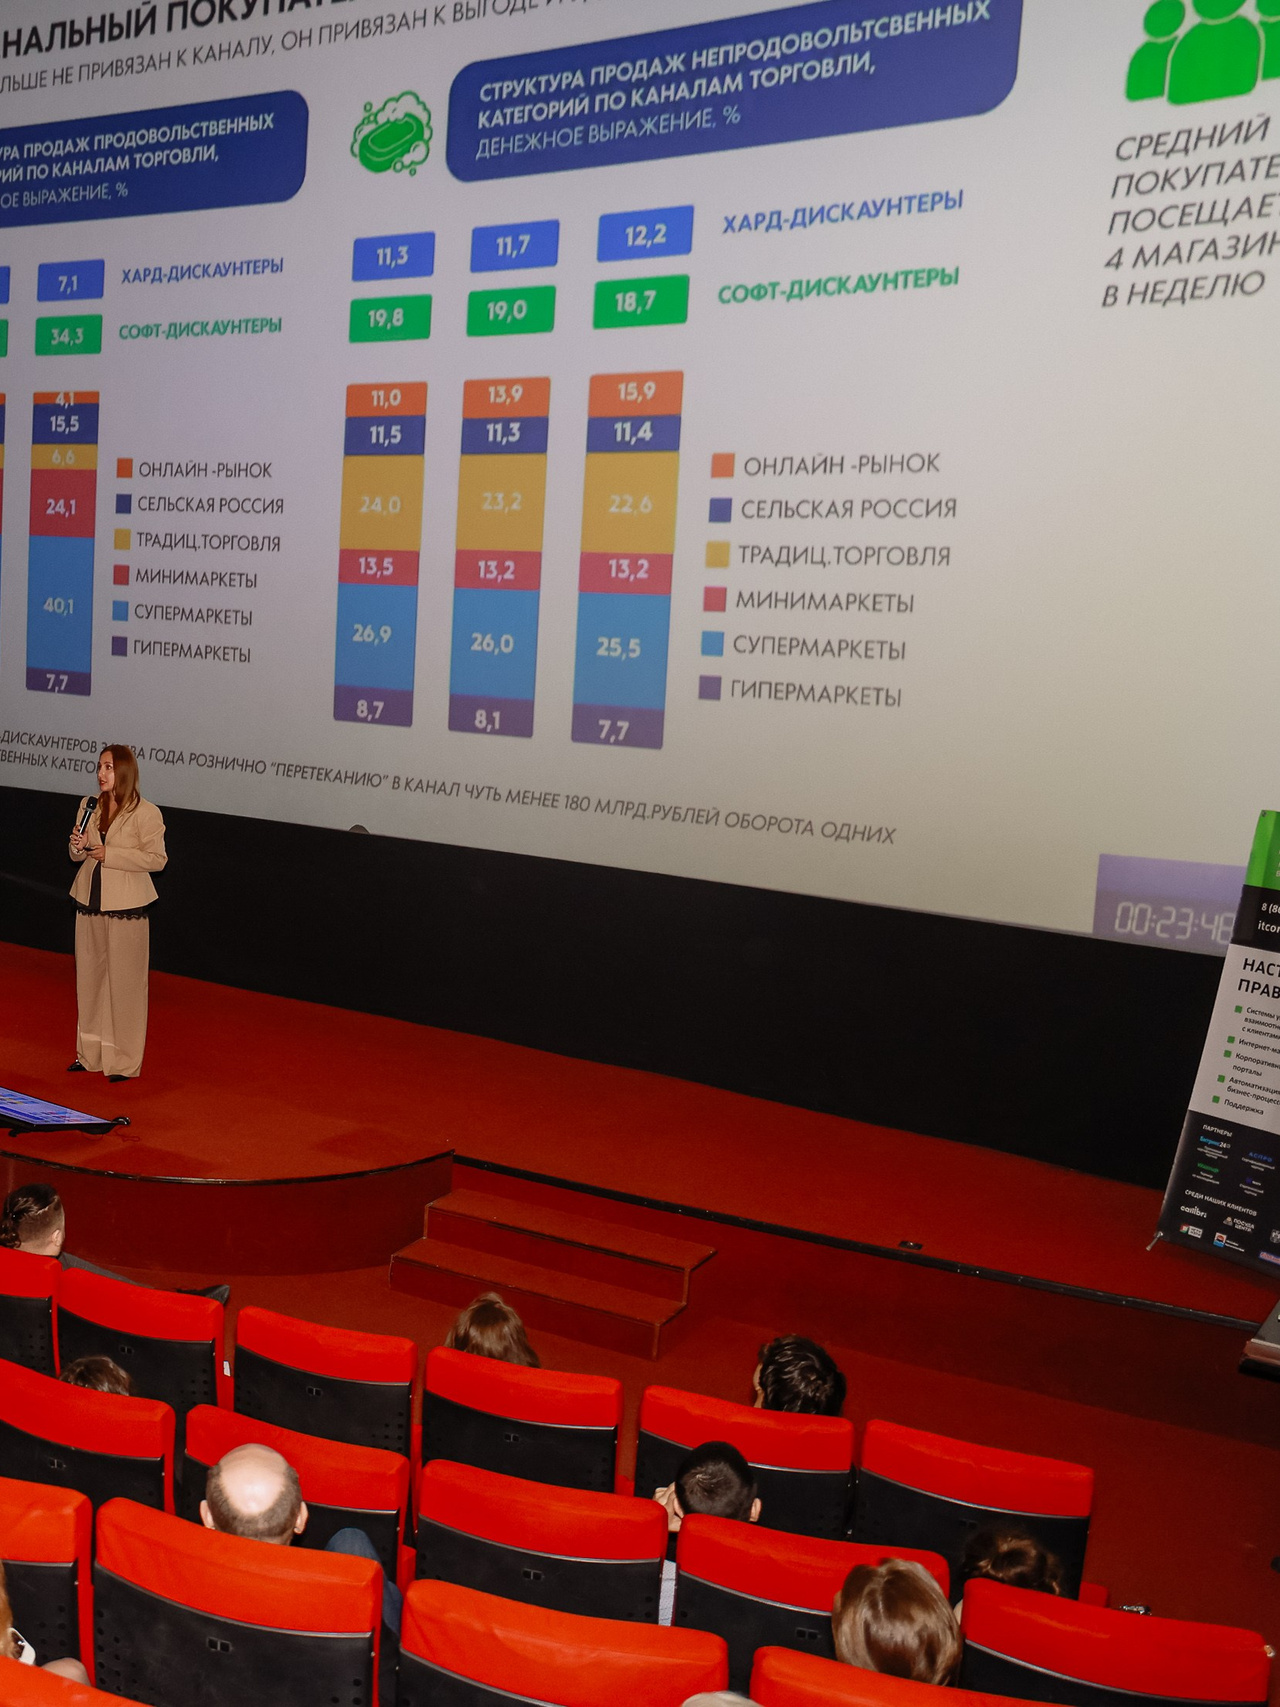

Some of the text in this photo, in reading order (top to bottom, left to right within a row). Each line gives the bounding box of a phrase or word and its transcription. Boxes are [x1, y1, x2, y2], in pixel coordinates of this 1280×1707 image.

[52, 66, 73, 87] НЕ
[78, 51, 171, 83] ПРИВЯЗАН
[176, 48, 188, 68] К
[192, 33, 275, 66] КАНАЛУ,
[281, 27, 312, 51] ОН
[320, 14, 427, 46] ПРИВЯЗАН
[434, 5, 446, 26] К
[480, 0, 990, 102] СТРУКТУРА ПРОДАЖ НЕПРОДОВОЛЬТСВЕННЫХ
[478, 51, 875, 130] КАТЕГОРИЙ ПО КАНАЛАМ ТОРГОВЛИ,
[23, 136, 90, 159] ПРОДАЖ
[93, 112, 275, 152] ПРОДОВОЛЬСТВЕННЫХ
[475, 105, 741, 161] ДЕНЕЖНОЕ ВЫРАЖЕНИЕ, %
[1115, 112, 1271, 162] СРЕДНИЙ
[27, 163, 49, 181] ПО
[52, 155, 130, 178] КАНАЛАМ
[134, 144, 220, 169] ТОРГОВЛИ,
[23, 182, 112, 207] ВЫРАЖЕНИЕ,
[116, 182, 128, 198] %
[722, 188, 964, 235] ХАРД-ДИСКАУНТЕРЫ
[1108, 192, 1280, 236] ПОСЕЩАЕ
[496, 234, 531, 259] 11,7
[625, 223, 667, 249] 12,2
[377, 245, 409, 270] 11,3
[1104, 247, 1124, 271] 4
[121, 257, 284, 285] ХАРД-ДИСКАУНТЕРЫ
[58, 275, 78, 295] 7,1
[718, 265, 960, 305] СОФТ-ДИСКАУНТЕРЫ
[1102, 270, 1266, 308] В НЕДЕЛЮ
[487, 299, 527, 324] 19,0
[615, 289, 657, 314] 18,7
[119, 317, 283, 341] СОФТ-ДИСКАУНТЕРЫ
[368, 307, 404, 330] 19,8
[50, 327, 84, 346] 34,3
[55, 391, 74, 408] 4,1
[371, 389, 401, 410] 11,0
[488, 385, 523, 406] 13,9
[618, 381, 656, 404] 15,9
[50, 415, 79, 434] 15,5
[369, 424, 401, 447] 11,5
[486, 422, 521, 445] 11,3
[614, 421, 653, 446] 11,4
[139, 460, 273, 478] ОНЛАЙН -РЫНОК
[744, 452, 941, 477] ОНЛАЙН -РЫНОК
[46, 498, 76, 516] 24,1
[138, 496, 284, 514] СЕЛЬСКАЯ РОССИЯ
[360, 496, 401, 516] 24,0
[482, 492, 522, 515] 23,2
[609, 494, 653, 517] 22,6
[741, 497, 957, 520] СЕЛЬСКАЯ РОССИЯ
[137, 532, 280, 552] ТРАДИЦ.ТОРГОВЛЯ
[358, 556, 393, 578] 13,5
[738, 544, 951, 569] ТРАДИЦ.ТОРГОВЛЯ
[135, 568, 257, 589] МИНИМАРКЕТЫ
[478, 560, 515, 581] 13,2
[608, 559, 649, 581] 13,2
[43, 597, 73, 617] 40,1
[735, 590, 915, 614] МИНИМАРКЕТЫ
[134, 604, 253, 626] СУПЕРМАРКЕТЫ
[352, 623, 392, 646] 26,9
[470, 633, 514, 656] 26,0
[133, 639, 251, 663] ГИПЕРМАРКЕТЫ
[596, 636, 642, 661] 25,5
[733, 634, 906, 661] СУПЕРМАРКЕТЫ
[46, 674, 69, 693] 7,7
[730, 679, 902, 708] ГИПЕРМАРКЕТЫ
[356, 699, 385, 722] 8,7
[474, 708, 500, 733] 8,1
[598, 719, 630, 744] 7,7
[148, 747, 186, 765] ГОДА
[188, 753, 267, 775] РОЗНИЧНО
[391, 776, 401, 790] В
[404, 778, 460, 798] КАНАЛ
[464, 784, 502, 803] ЧУТЬ
[505, 788, 561, 810] МЕНЕЕ
[564, 793, 590, 812] 180
[724, 811, 815, 837] ОБОРОТА
[820, 821, 898, 845] ОДНИХ
[1261, 902, 1267, 911] 8
[1114, 901, 1236, 945] 00:23:48
[1238, 978, 1280, 999] ПРАВ
